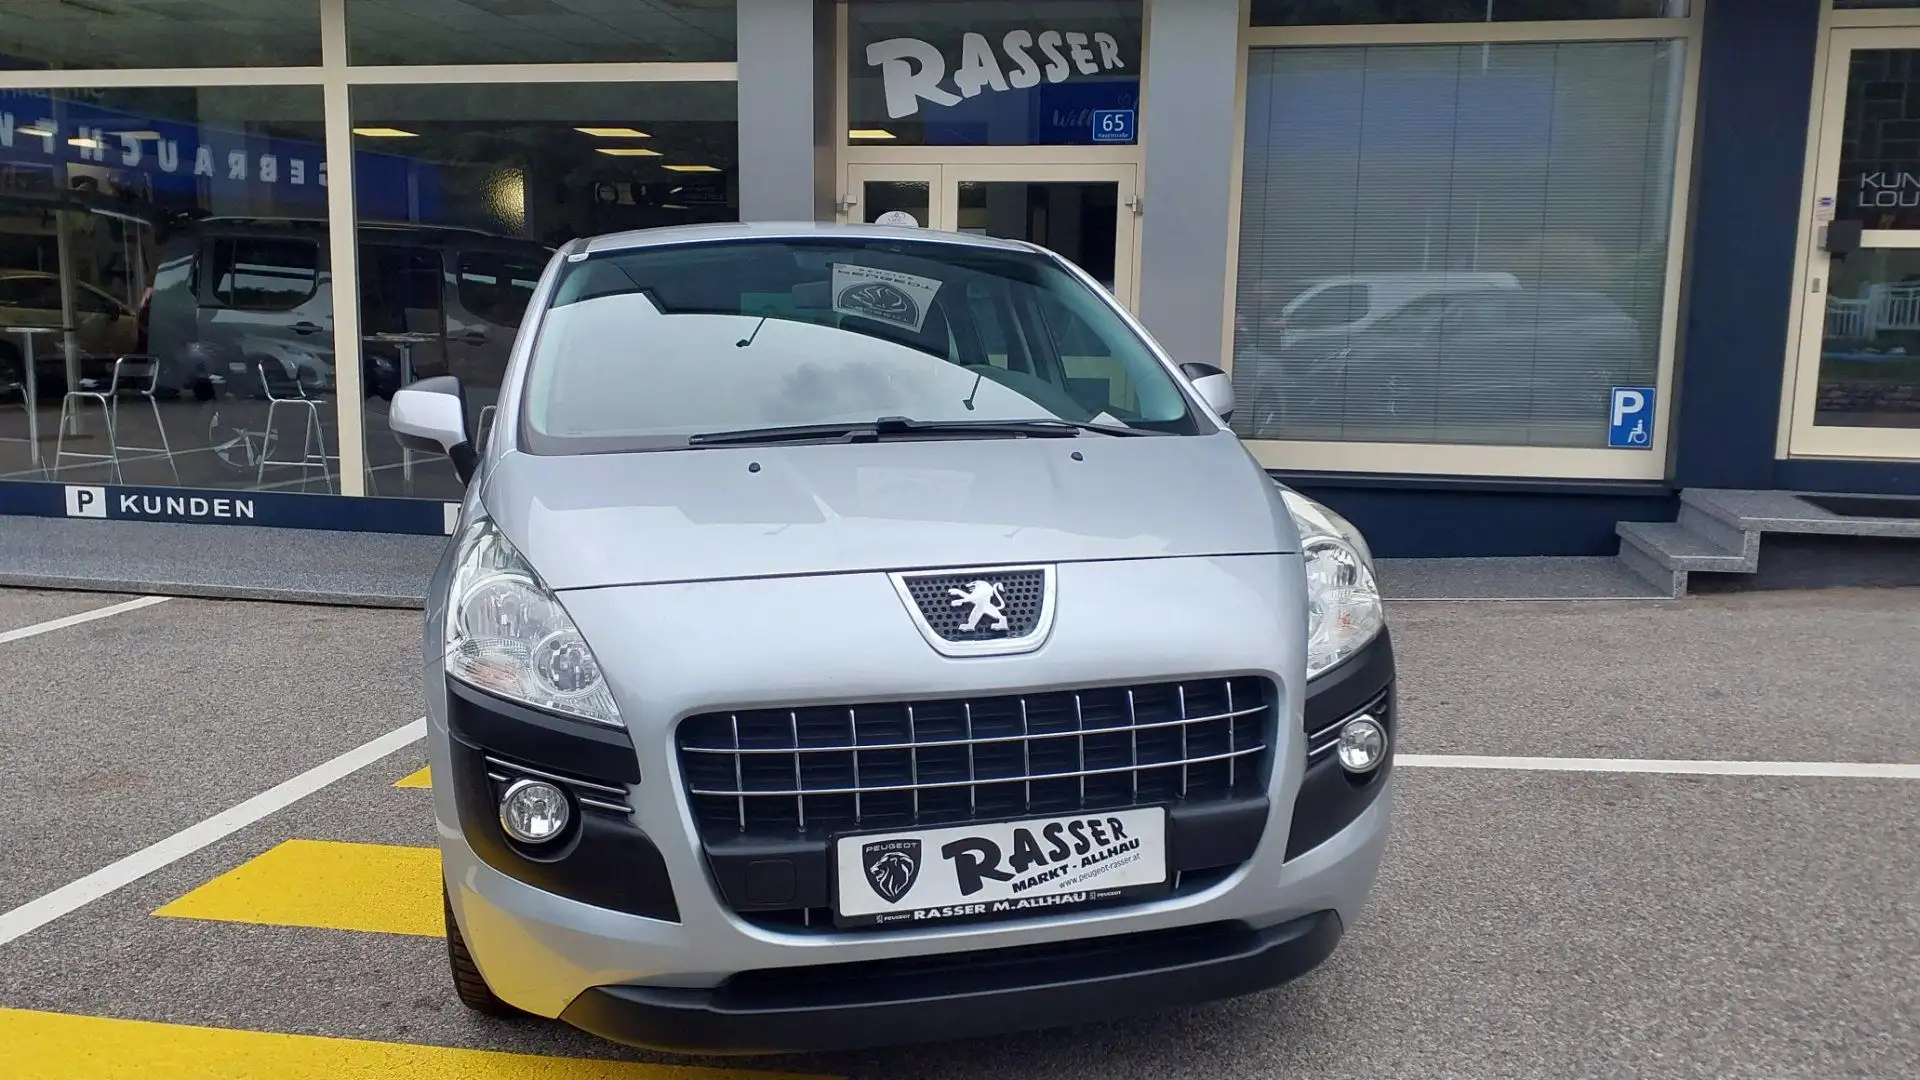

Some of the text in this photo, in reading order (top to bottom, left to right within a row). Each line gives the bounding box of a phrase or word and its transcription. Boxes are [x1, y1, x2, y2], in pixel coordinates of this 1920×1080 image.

[866, 30, 1125, 119] RASSER
[1102, 114, 1124, 131] 65
[1859, 191, 1920, 207] LOU
[1613, 390, 1645, 426] P
[77, 490, 255, 519] P KUNDEN
[866, 842, 918, 853] PEUGEOT
[941, 817, 1128, 896] RASSER
[1012, 864, 1069, 894] MARKT
[1081, 838, 1140, 868] ALLHAU
[1059, 853, 1141, 889] www.peugeot-rasser.at
[914, 904, 986, 920] RASSER
[993, 892, 1087, 911] M.ALLHAU
